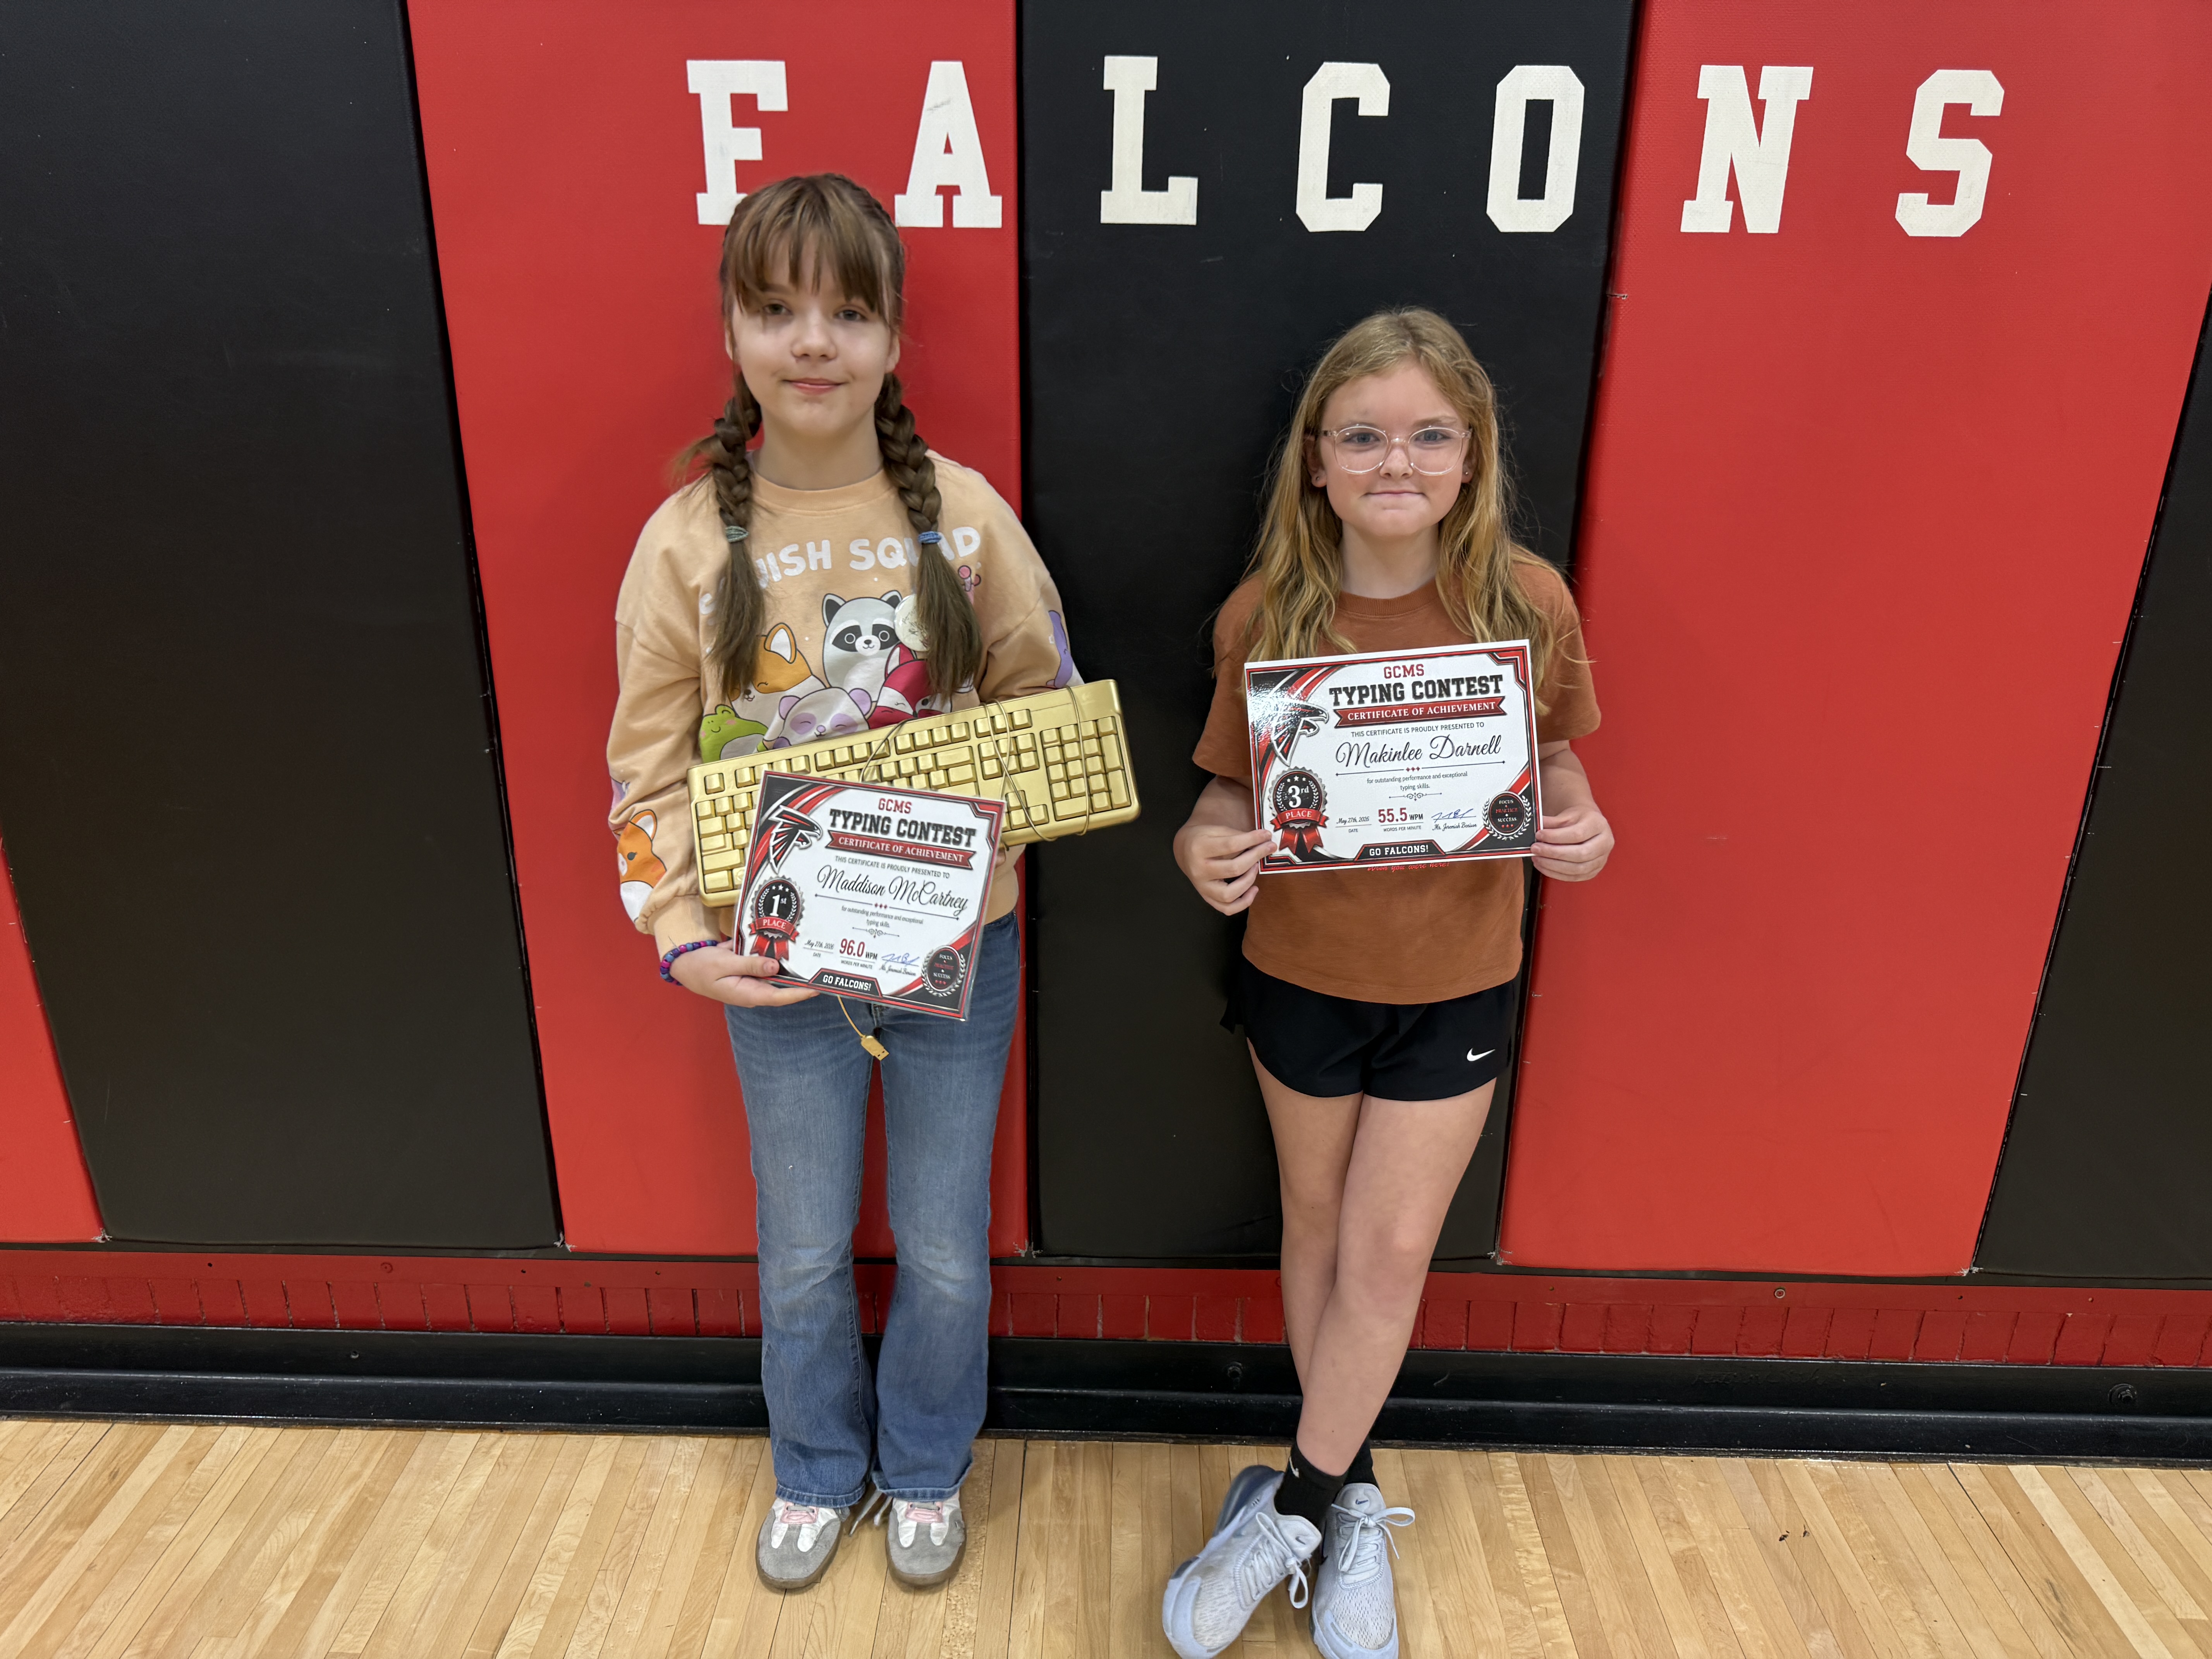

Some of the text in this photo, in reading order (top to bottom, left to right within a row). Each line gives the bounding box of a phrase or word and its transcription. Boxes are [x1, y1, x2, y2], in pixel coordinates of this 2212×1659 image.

[686, 55, 2005, 237] FALCONS
[1384, 664, 1424, 679] GCMS
[1329, 675, 1503, 706] TYPING CONTEST
[1348, 702, 1496, 721] CERTIFICATE OF ACHIEVEMENT
[1366, 728, 1402, 736] CERTIFICATE
[1411, 725, 1438, 733] PROUDLY
[1441, 723, 1474, 731] PRESENTED
[1336, 734, 1501, 768] Makinlee Darnell
[1288, 785, 1309, 808] 3rd
[878, 798, 912, 814] GCMS
[1285, 810, 1312, 819] PLACE
[1378, 807, 1408, 823] 55.5
[829, 808, 977, 847] TYPING CONTEST
[838, 836, 964, 862] CERTIFICATE OF ACHIEVEMENT
[1369, 845, 1429, 856] GO FALCONS!
[848, 857, 879, 868] CERTIFICATE
[817, 864, 969, 916] Maddison McCartney
[763, 919, 787, 929] PLACE
[839, 938, 865, 957] 96.0
[866, 951, 878, 960] WPM
[823, 974, 871, 991] GO FALCONS!
